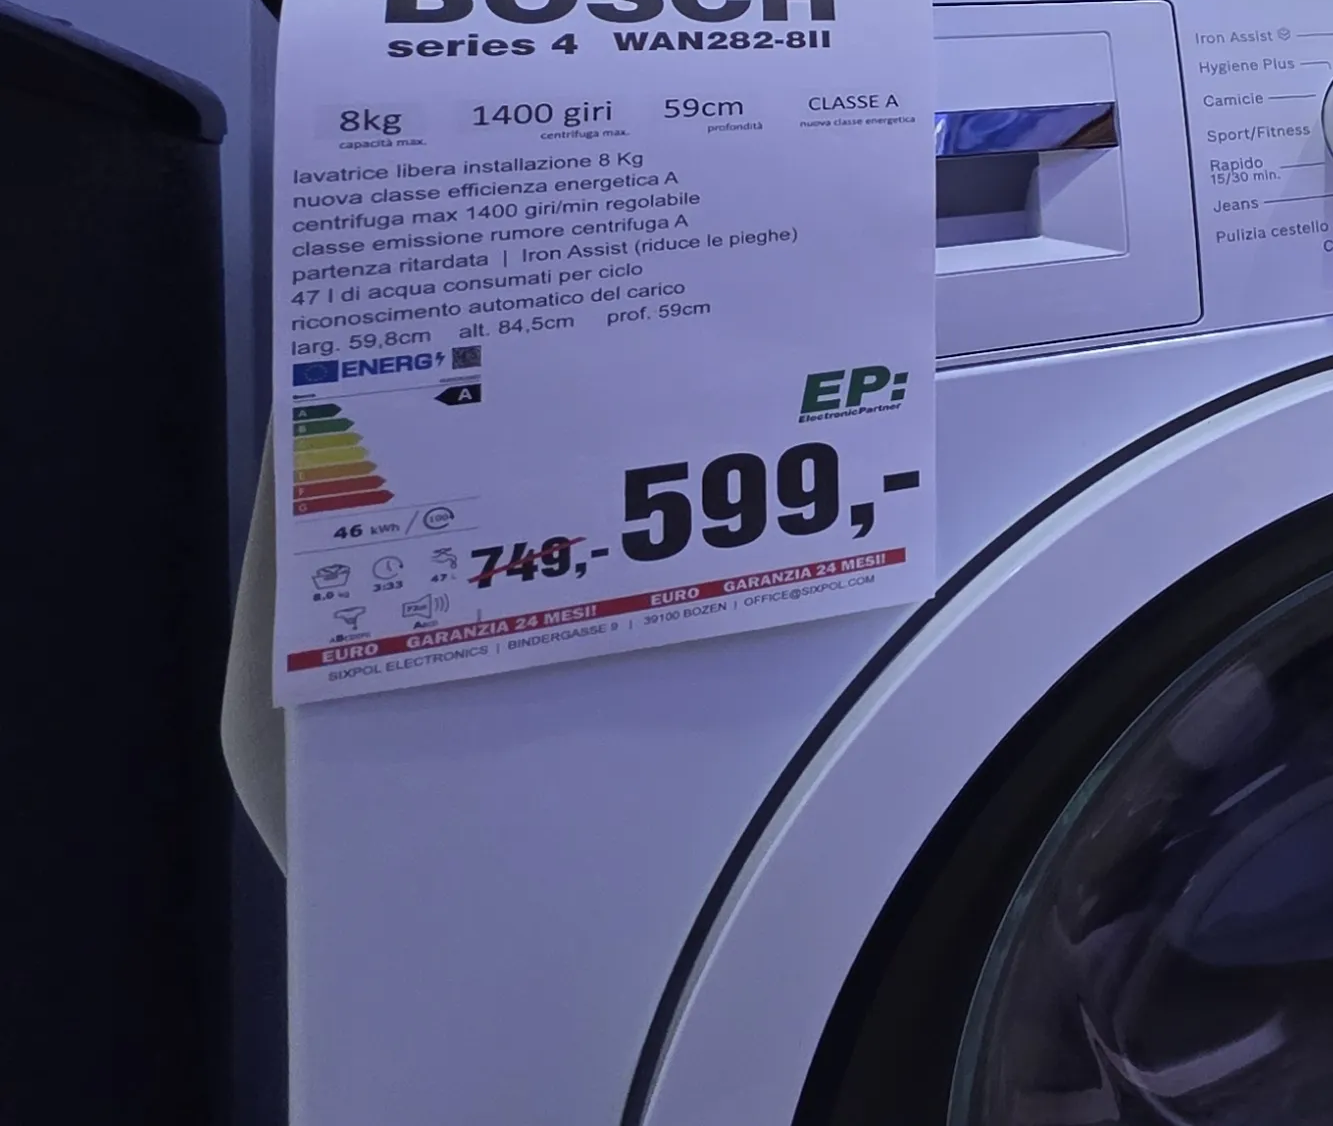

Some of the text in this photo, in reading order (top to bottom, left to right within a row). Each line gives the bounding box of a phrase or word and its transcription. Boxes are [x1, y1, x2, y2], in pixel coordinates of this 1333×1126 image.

[387, 34, 536, 57] series
[551, 33, 578, 55] 4
[1195, 30, 1274, 44] Iron Assist
[1199, 57, 1295, 76] Hygiene Plus
[339, 94, 900, 135] 8kg 1400 giri 59cm CLASSE A
[1203, 92, 1264, 107] Camicie
[339, 115, 916, 151] capacità centrifuga profondità classe energetica
[1207, 125, 1311, 144] Sport/Fitness
[293, 151, 643, 184] lavatrice libera installazione 8 Kg
[1210, 158, 1263, 175] Rapido
[1211, 170, 1281, 185] 15/30 min.
[293, 171, 679, 209] nuova classe efficienza energetica A
[1213, 197, 1259, 213] Jeans
[292, 192, 700, 233] centrifuga max 1400 giri/min regolabile
[292, 214, 689, 258] classe emissione rumore centrifuga A
[1216, 220, 1329, 244] Pulizia cestello
[292, 227, 798, 285] partenza ritardata Iron Assist (riduce le pieghe)
[291, 263, 643, 306] 47 di acqua consumati per ciclo
[291, 281, 686, 331] riconoscimento automatico del carico
[291, 301, 711, 357] larg. 59,8cm alt. 84,5cm prof. 59cm
[341, 353, 433, 379] ENERG
[457, 388, 473, 401] A
[800, 365, 909, 414] EP:
[798, 402, 902, 424] ElectronicPartner
[471, 441, 920, 590] 749,- 599,-
[333, 525, 363, 540] 46
[322, 553, 887, 664] EURO GARANZIA 24 MESI! EURO GARANZIA 24 MESI!
[328, 574, 876, 682] SIXPOL ELECTRONICS BINDERGASSE 9 39100 BOZEN OFFICE@SIXPOL.COM
